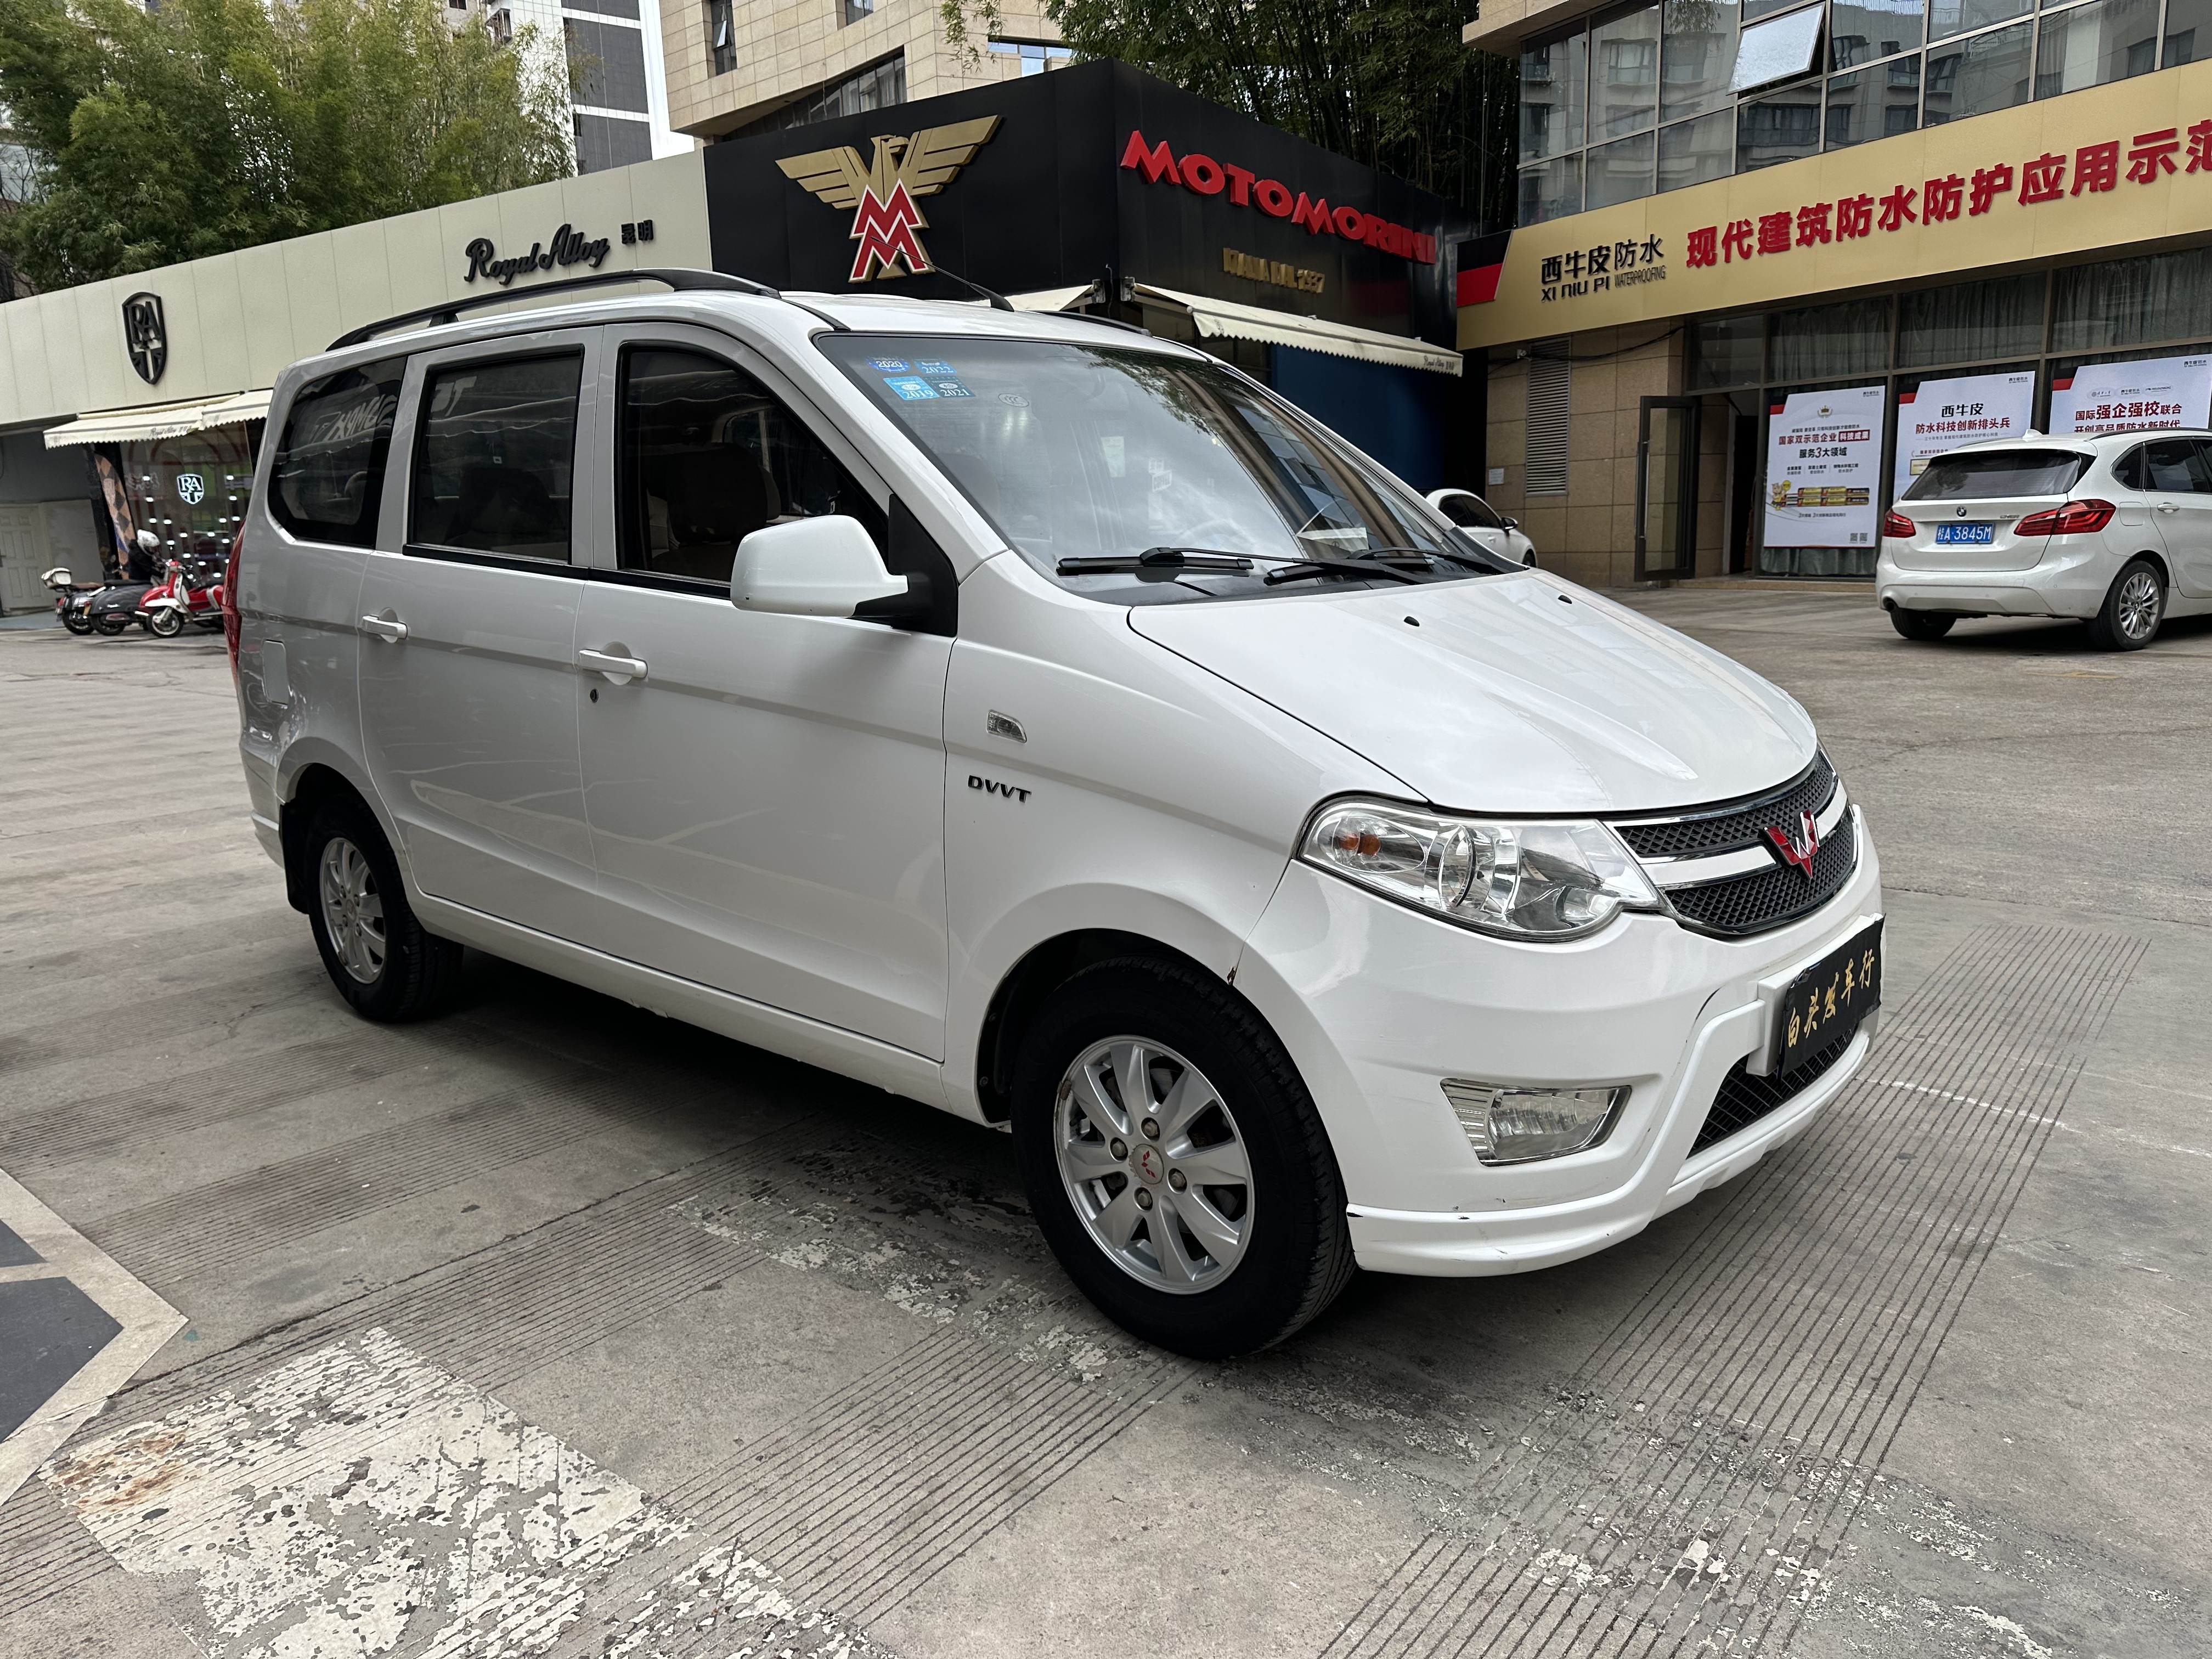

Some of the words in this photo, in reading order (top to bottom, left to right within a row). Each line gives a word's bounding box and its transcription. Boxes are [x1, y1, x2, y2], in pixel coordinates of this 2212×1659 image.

[621, 219, 653, 244] 昆明
[464, 238, 540, 285] Royal
[538, 223, 610, 269] Alloy
[1542, 234, 1664, 285] 西牛皮防水
[1542, 286, 1556, 302] XI
[1561, 280, 1588, 298] NIU
[1594, 276, 1610, 292] PI
[1615, 265, 1666, 287] WATERPROOFING
[902, 390, 934, 399] 2019
[1942, 403, 1984, 417] 西牛皮
[1916, 417, 2010, 434] 防水科技创新排头兵
[1779, 433, 1837, 445] 国家双示范企业
[1799, 447, 1847, 458] 服务3大领域
[180, 477, 202, 493] RA
[968, 775, 1032, 804] DVVT
